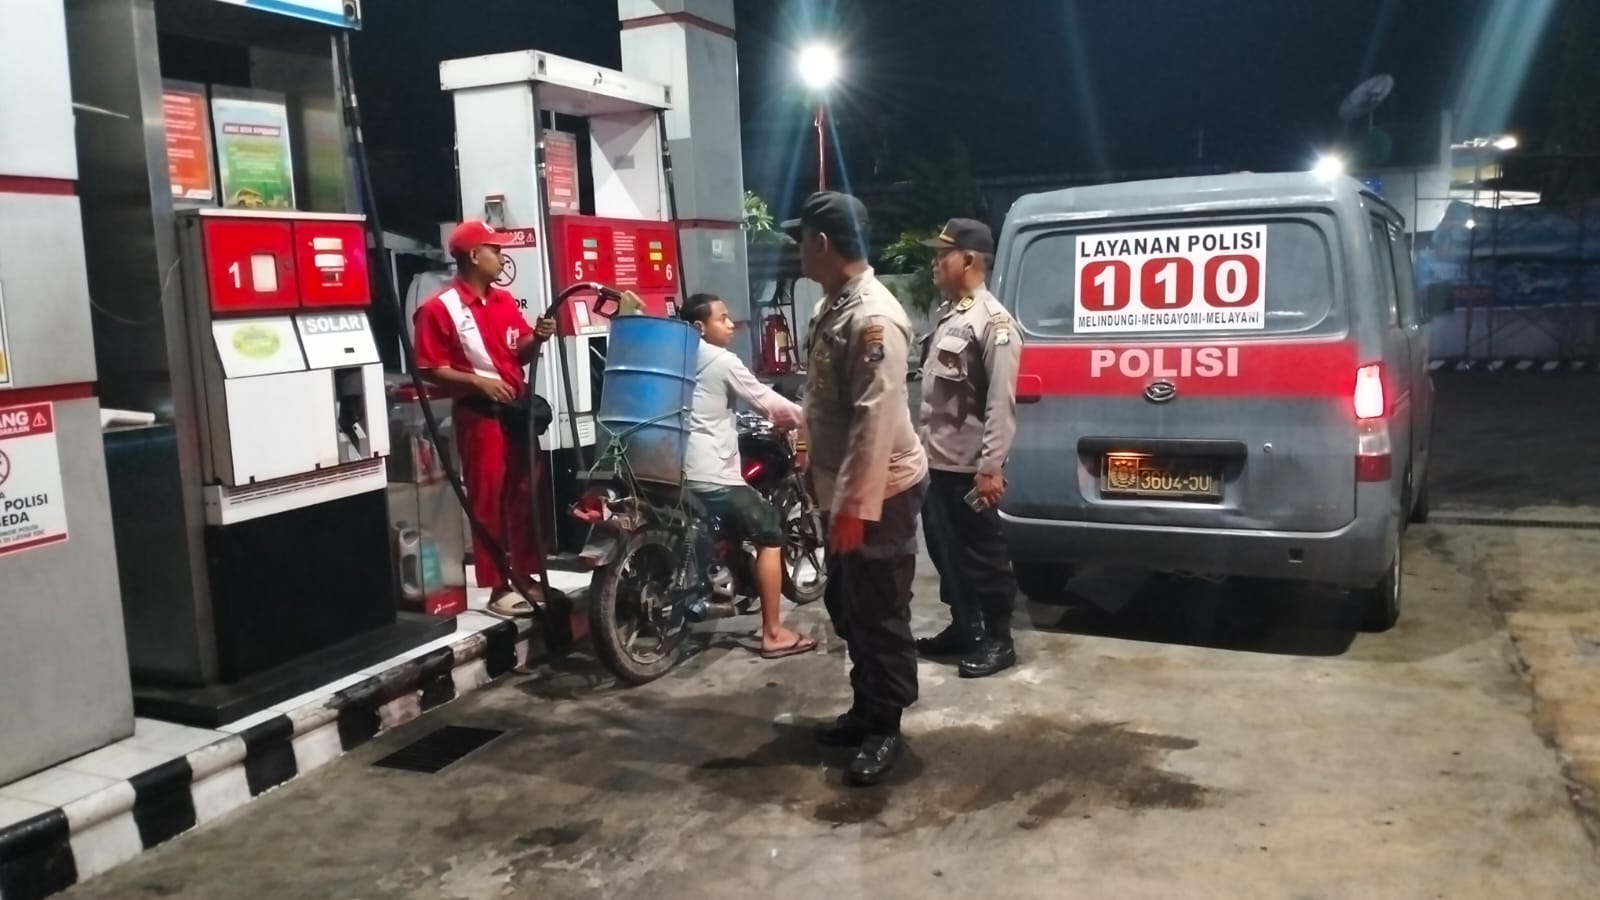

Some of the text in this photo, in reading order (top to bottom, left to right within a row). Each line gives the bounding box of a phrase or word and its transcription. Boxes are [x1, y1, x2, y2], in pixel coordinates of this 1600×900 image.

[1081, 231, 1261, 257] LAYANAN POLISI
[228, 261, 241, 289] 1
[574, 261, 583, 280] 5
[665, 264, 673, 280] 6
[305, 314, 361, 333] SOLAR
[1090, 347, 1239, 378] POLISI
[4, 493, 48, 512] POLISI
[0, 511, 30, 528] EDA
